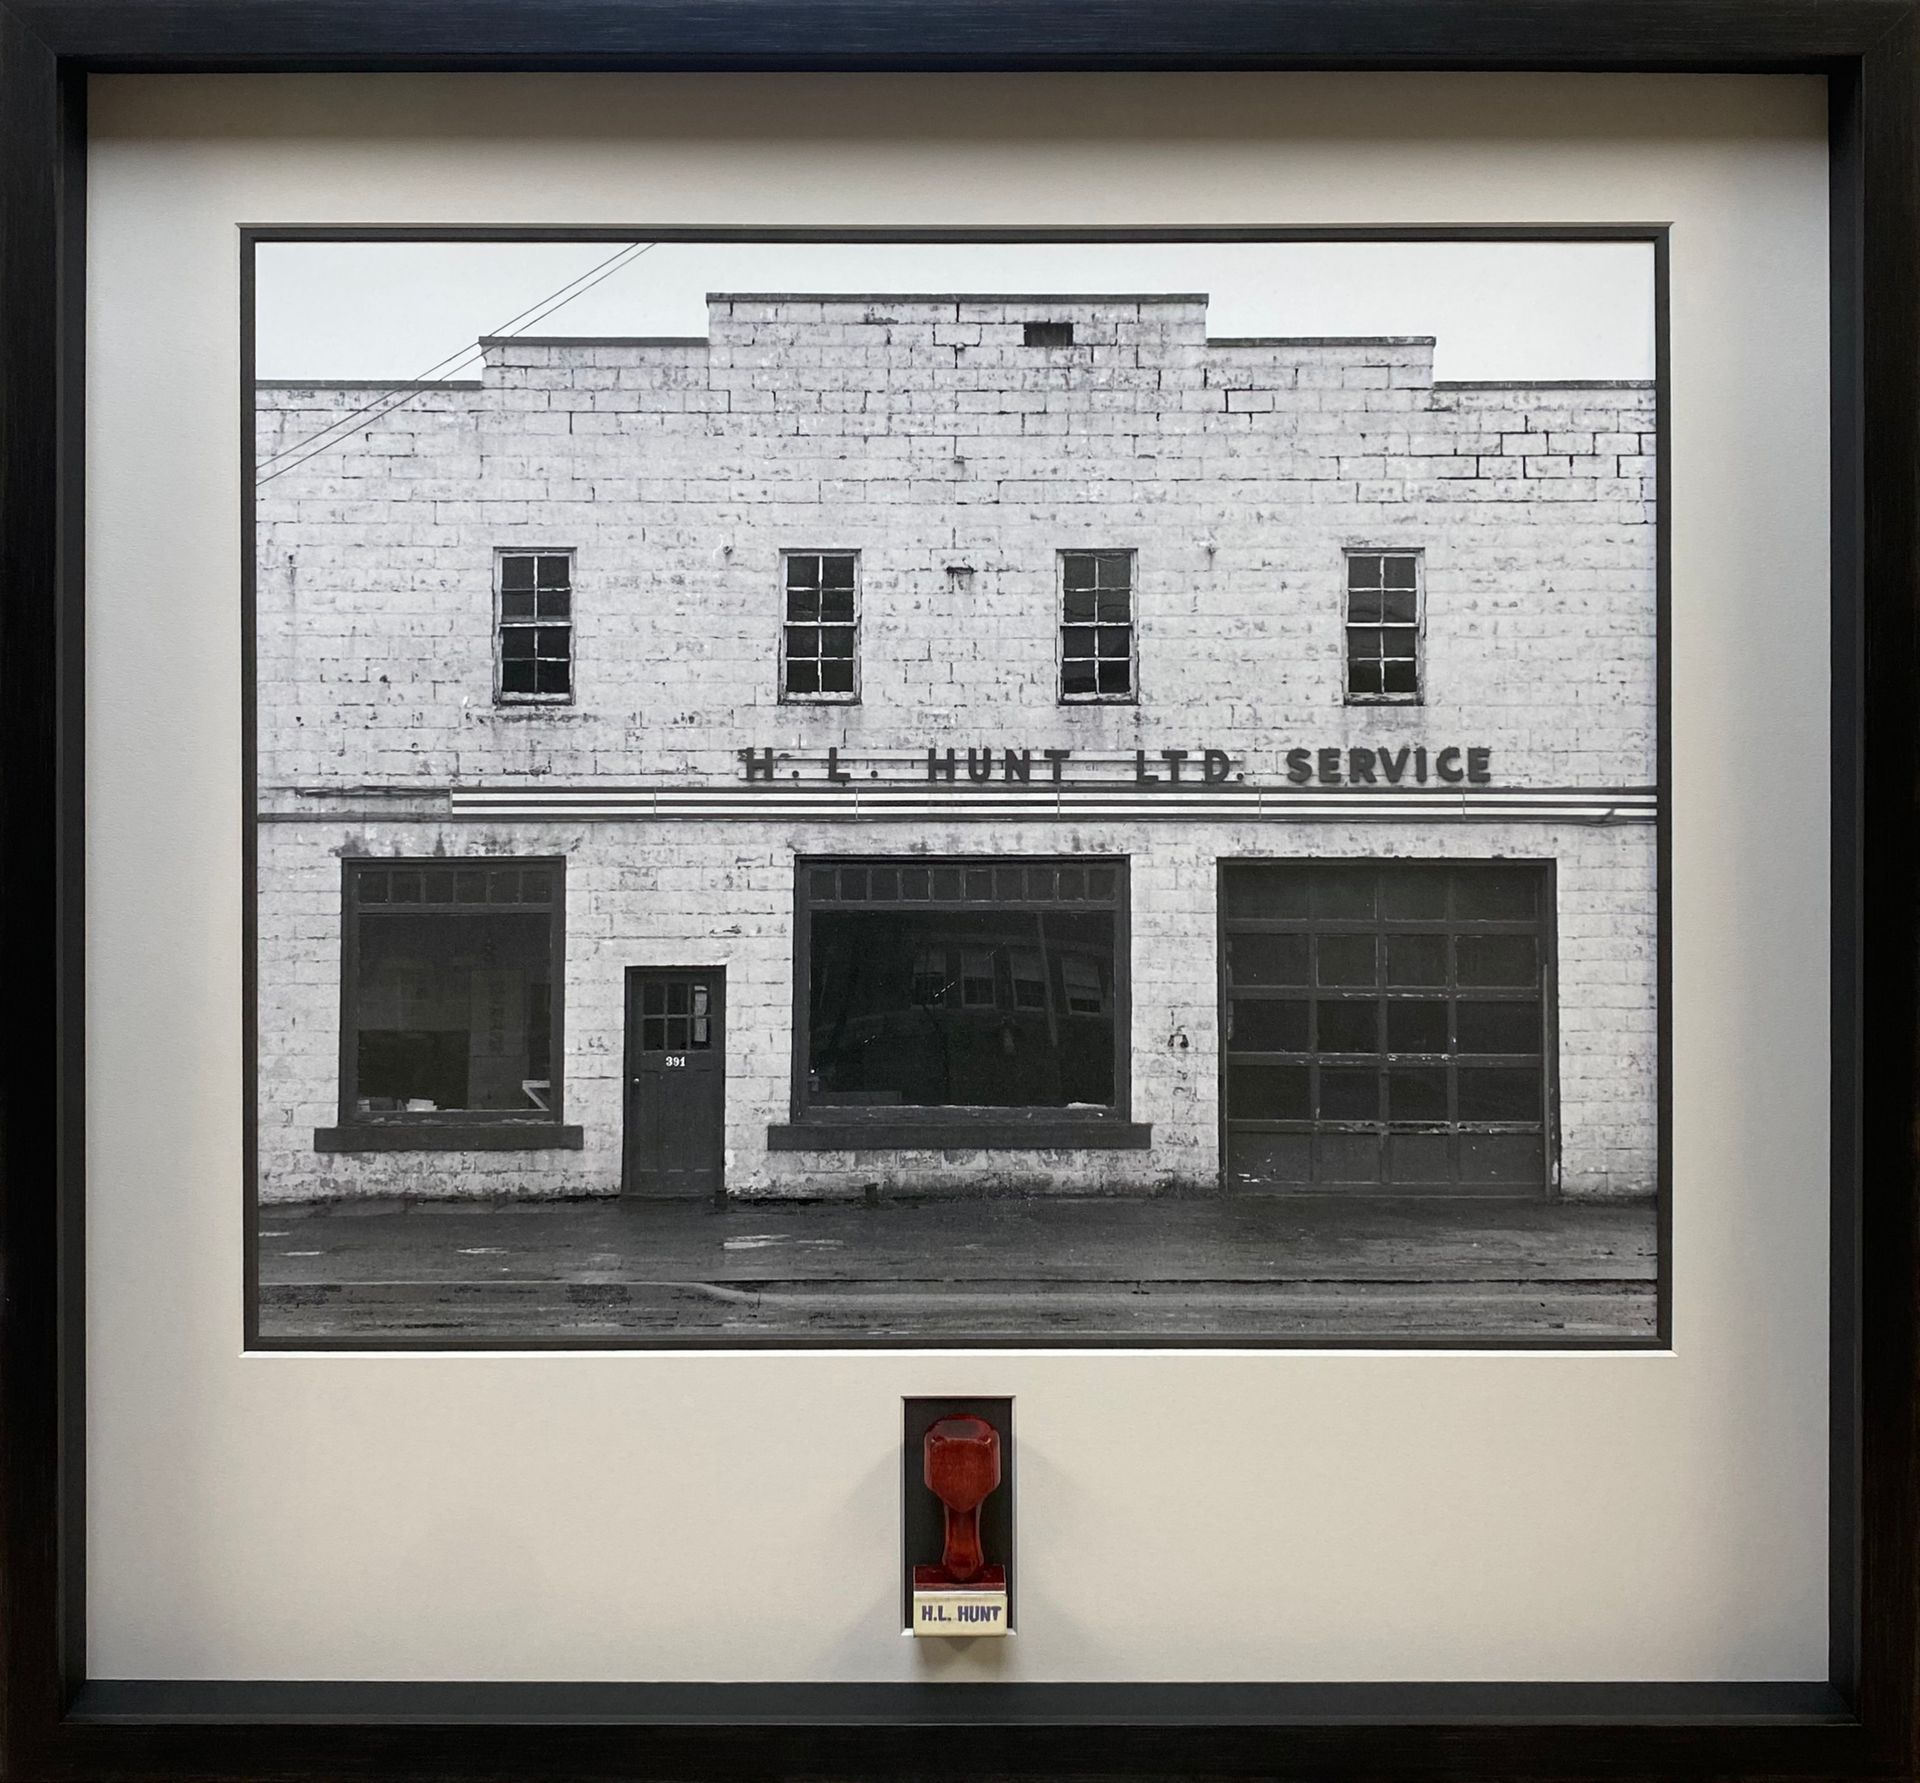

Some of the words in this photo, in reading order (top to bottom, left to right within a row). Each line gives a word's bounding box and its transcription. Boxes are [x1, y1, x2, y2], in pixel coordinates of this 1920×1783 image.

[746, 747, 800, 782] H.
[828, 747, 878, 781] L.
[928, 748, 1070, 783] HUNT
[1136, 749, 1245, 784] LTD.
[1286, 747, 1492, 783] SERVICE
[665, 1056, 686, 1067] 391
[921, 1605, 952, 1621] H.L.
[957, 1605, 1002, 1622] HUNT
